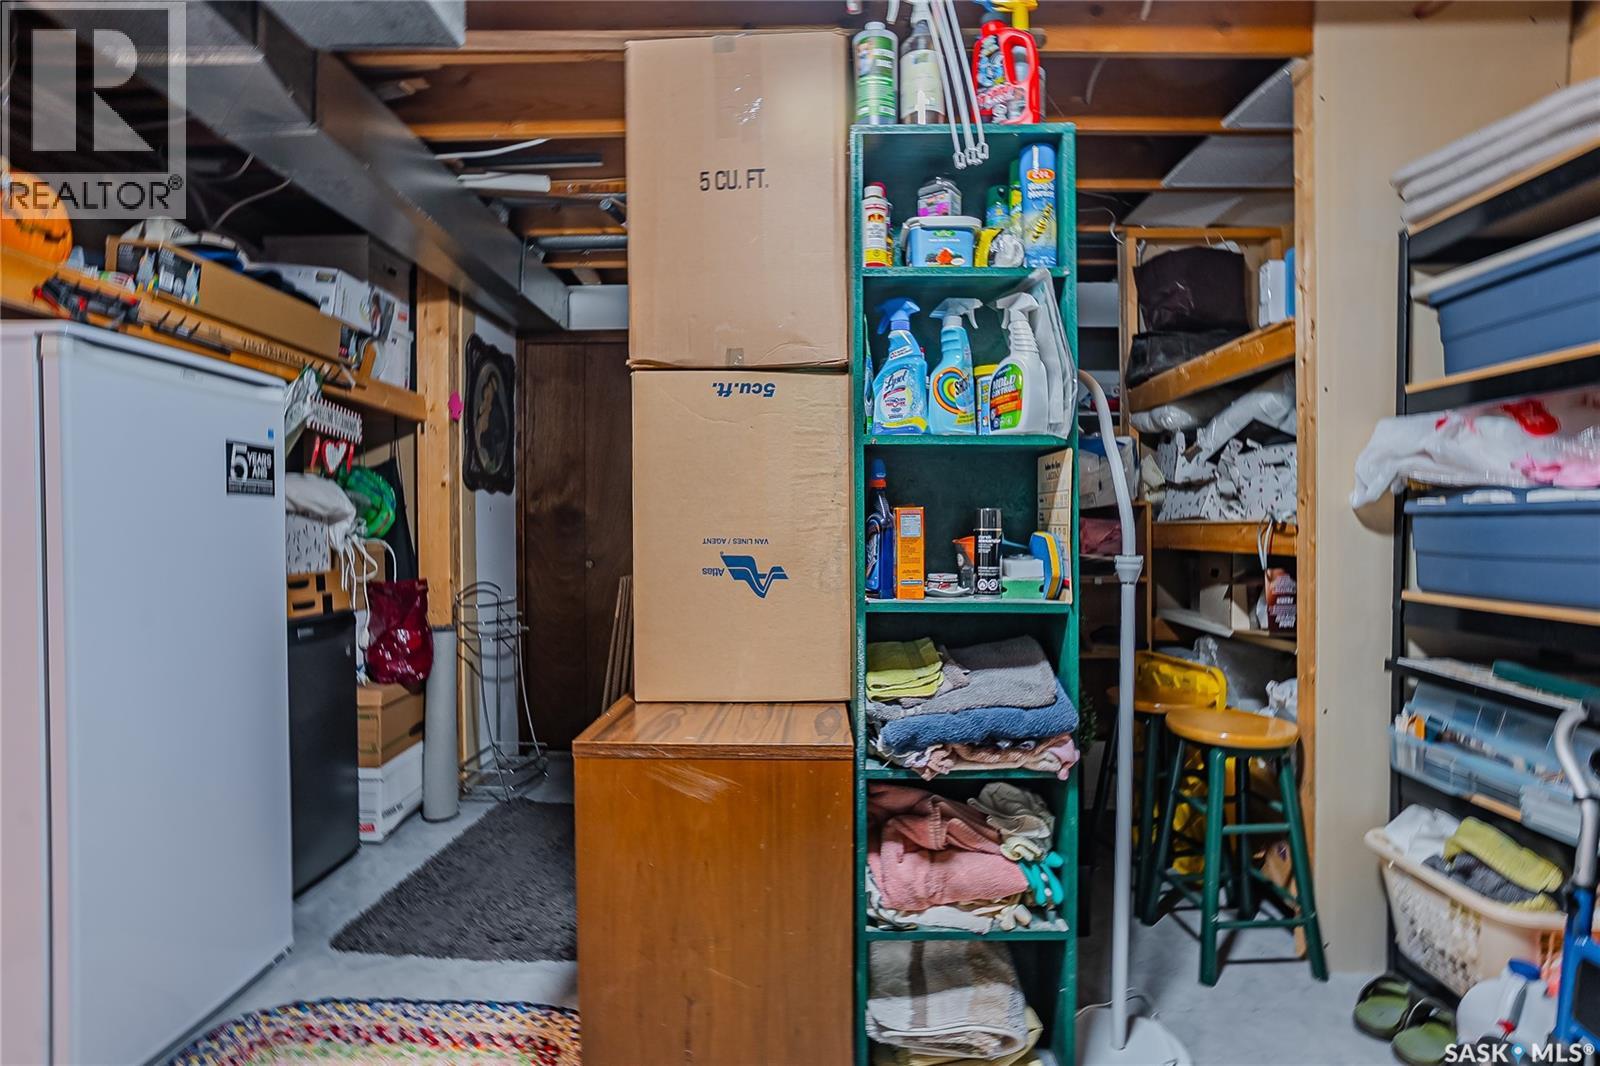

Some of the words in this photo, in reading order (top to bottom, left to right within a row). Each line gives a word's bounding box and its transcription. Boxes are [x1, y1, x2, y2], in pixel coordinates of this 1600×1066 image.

[700, 171, 710, 191] 5
[715, 169, 742, 190] CU.
[747, 168, 769, 189] FT.
[992, 374, 1017, 388] MOLD
[712, 382, 776, 398] 5cu.ft.
[230, 442, 249, 483] 5
[702, 537, 727, 545] AGENT
[733, 537, 753, 545] LINES
[702, 567, 725, 577] Atlas
